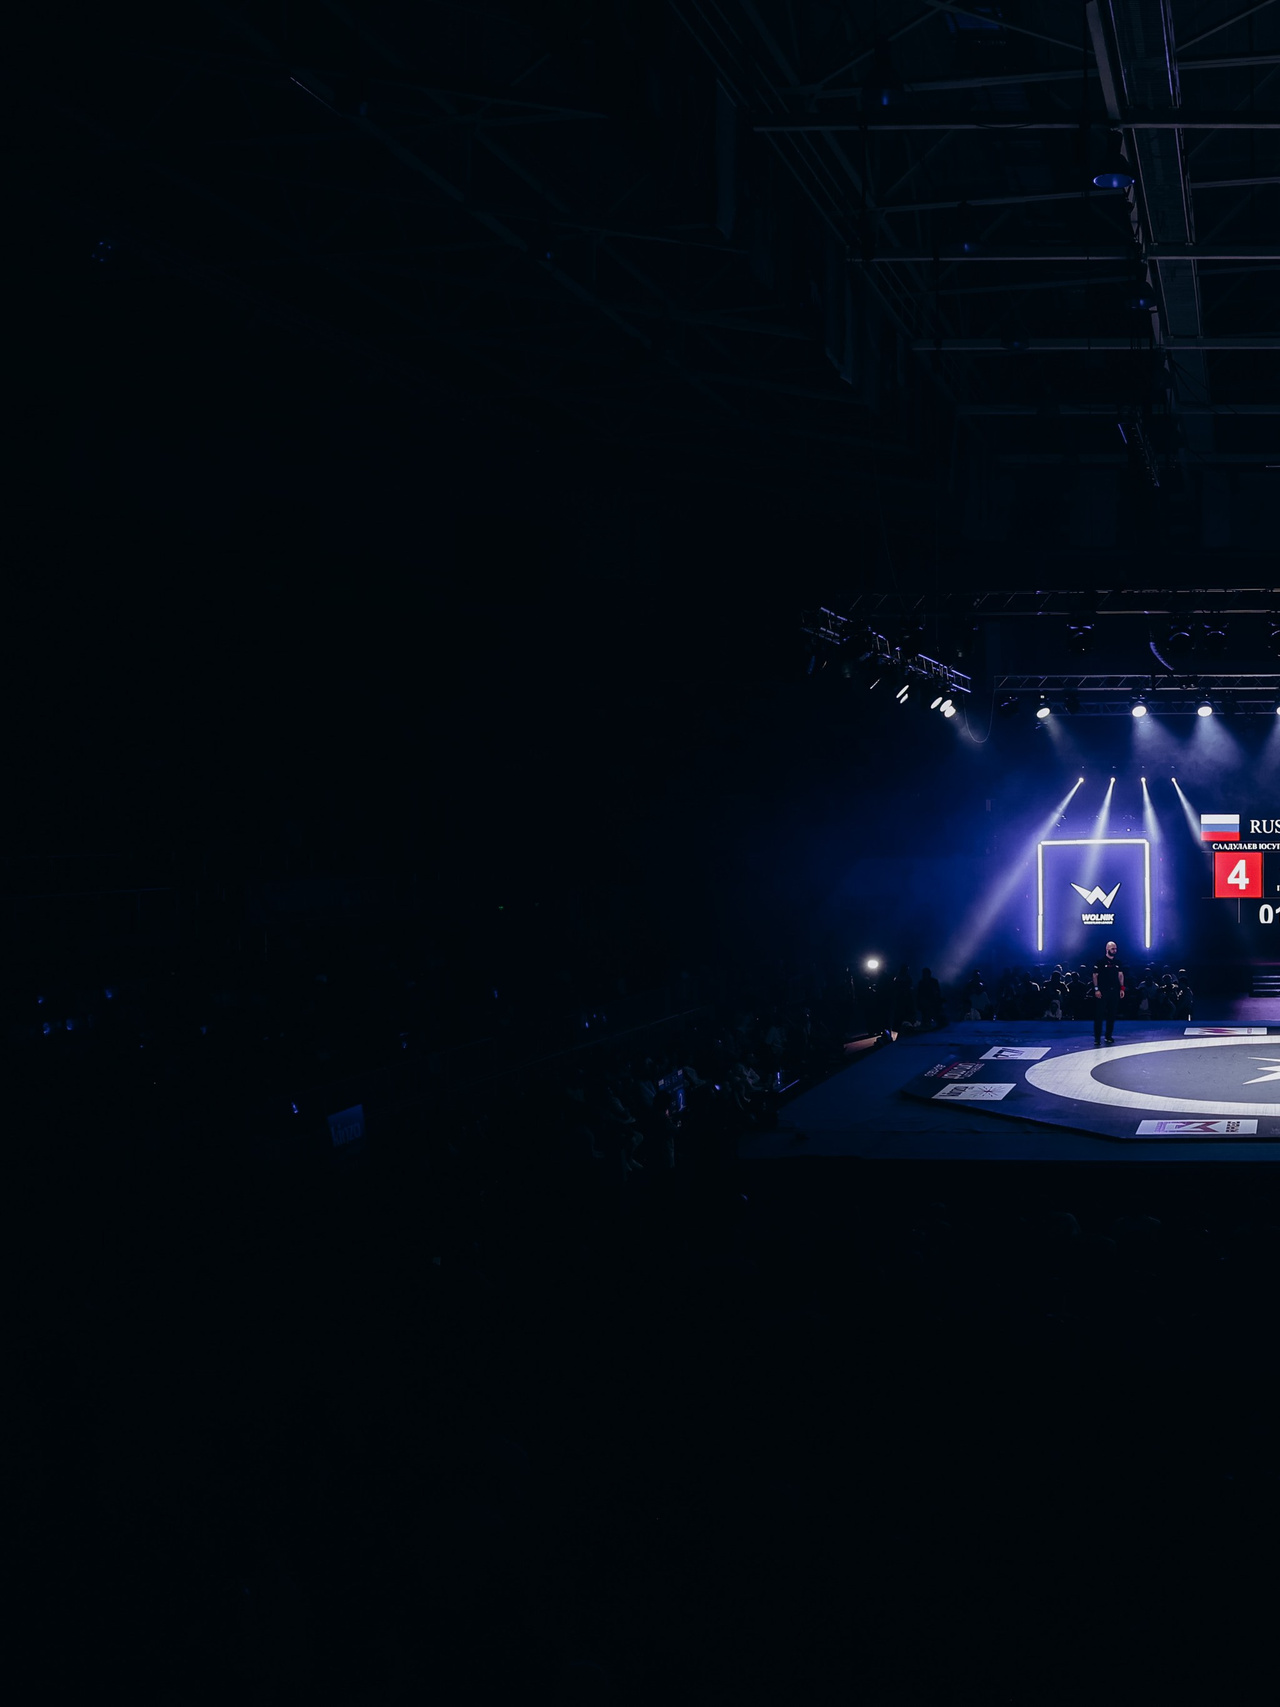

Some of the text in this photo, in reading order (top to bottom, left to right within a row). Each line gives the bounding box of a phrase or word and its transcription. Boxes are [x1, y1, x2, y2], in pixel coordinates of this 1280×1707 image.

[1212, 842, 1257, 851] СААДУЛАЕВ
[1227, 859, 1250, 890] 4
[1081, 913, 1115, 922] WOLNIK
